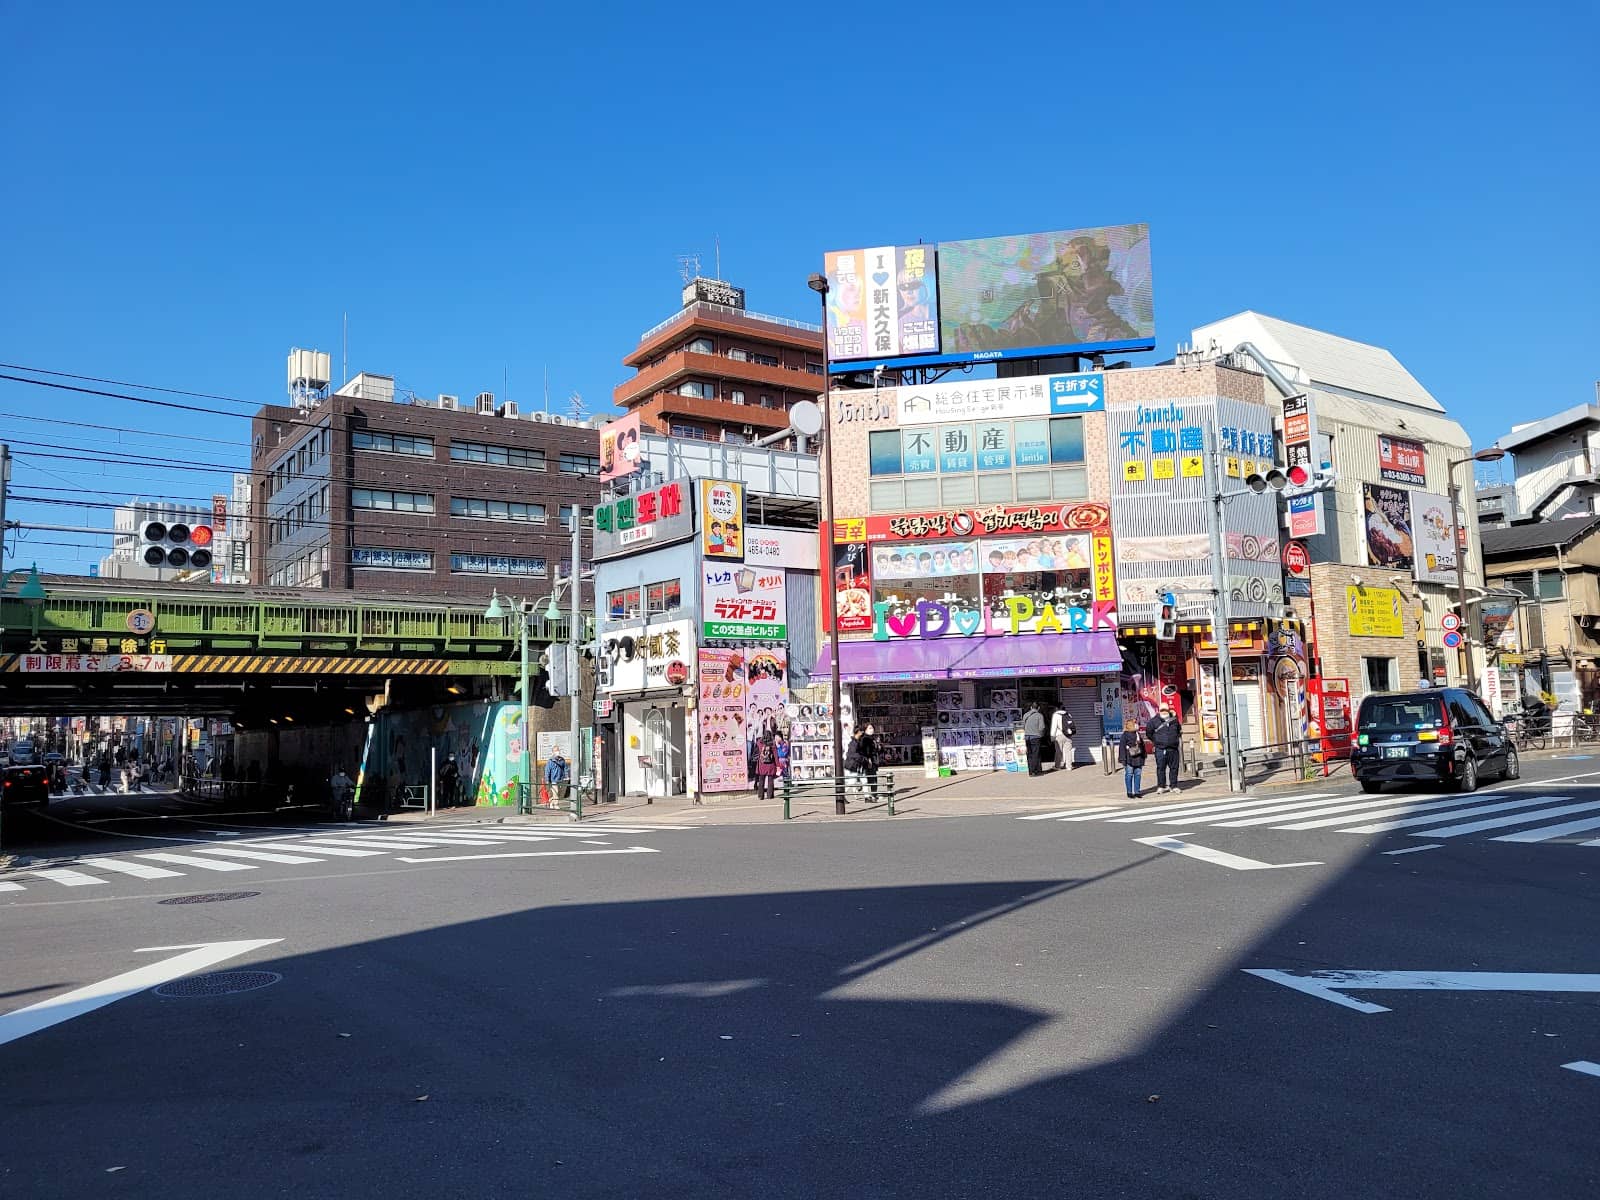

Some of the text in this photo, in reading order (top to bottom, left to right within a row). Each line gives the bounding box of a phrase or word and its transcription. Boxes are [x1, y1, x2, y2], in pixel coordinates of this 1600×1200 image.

[873, 289, 891, 352] 新大久保
[973, 351, 1004, 359] NAGATA
[935, 384, 1044, 405] 総合住宅展示場
[1053, 378, 1098, 393] 右折すぐ
[907, 428, 1006, 455] 不動産
[706, 571, 731, 584] トレカ
[1097, 539, 1111, 598] トッポッキ
[714, 604, 777, 620] ラストワン
[1004, 595, 1118, 635] PARK
[25, 656, 100, 670] 制限高さ
[1487, 670, 1497, 698] KIRIN
